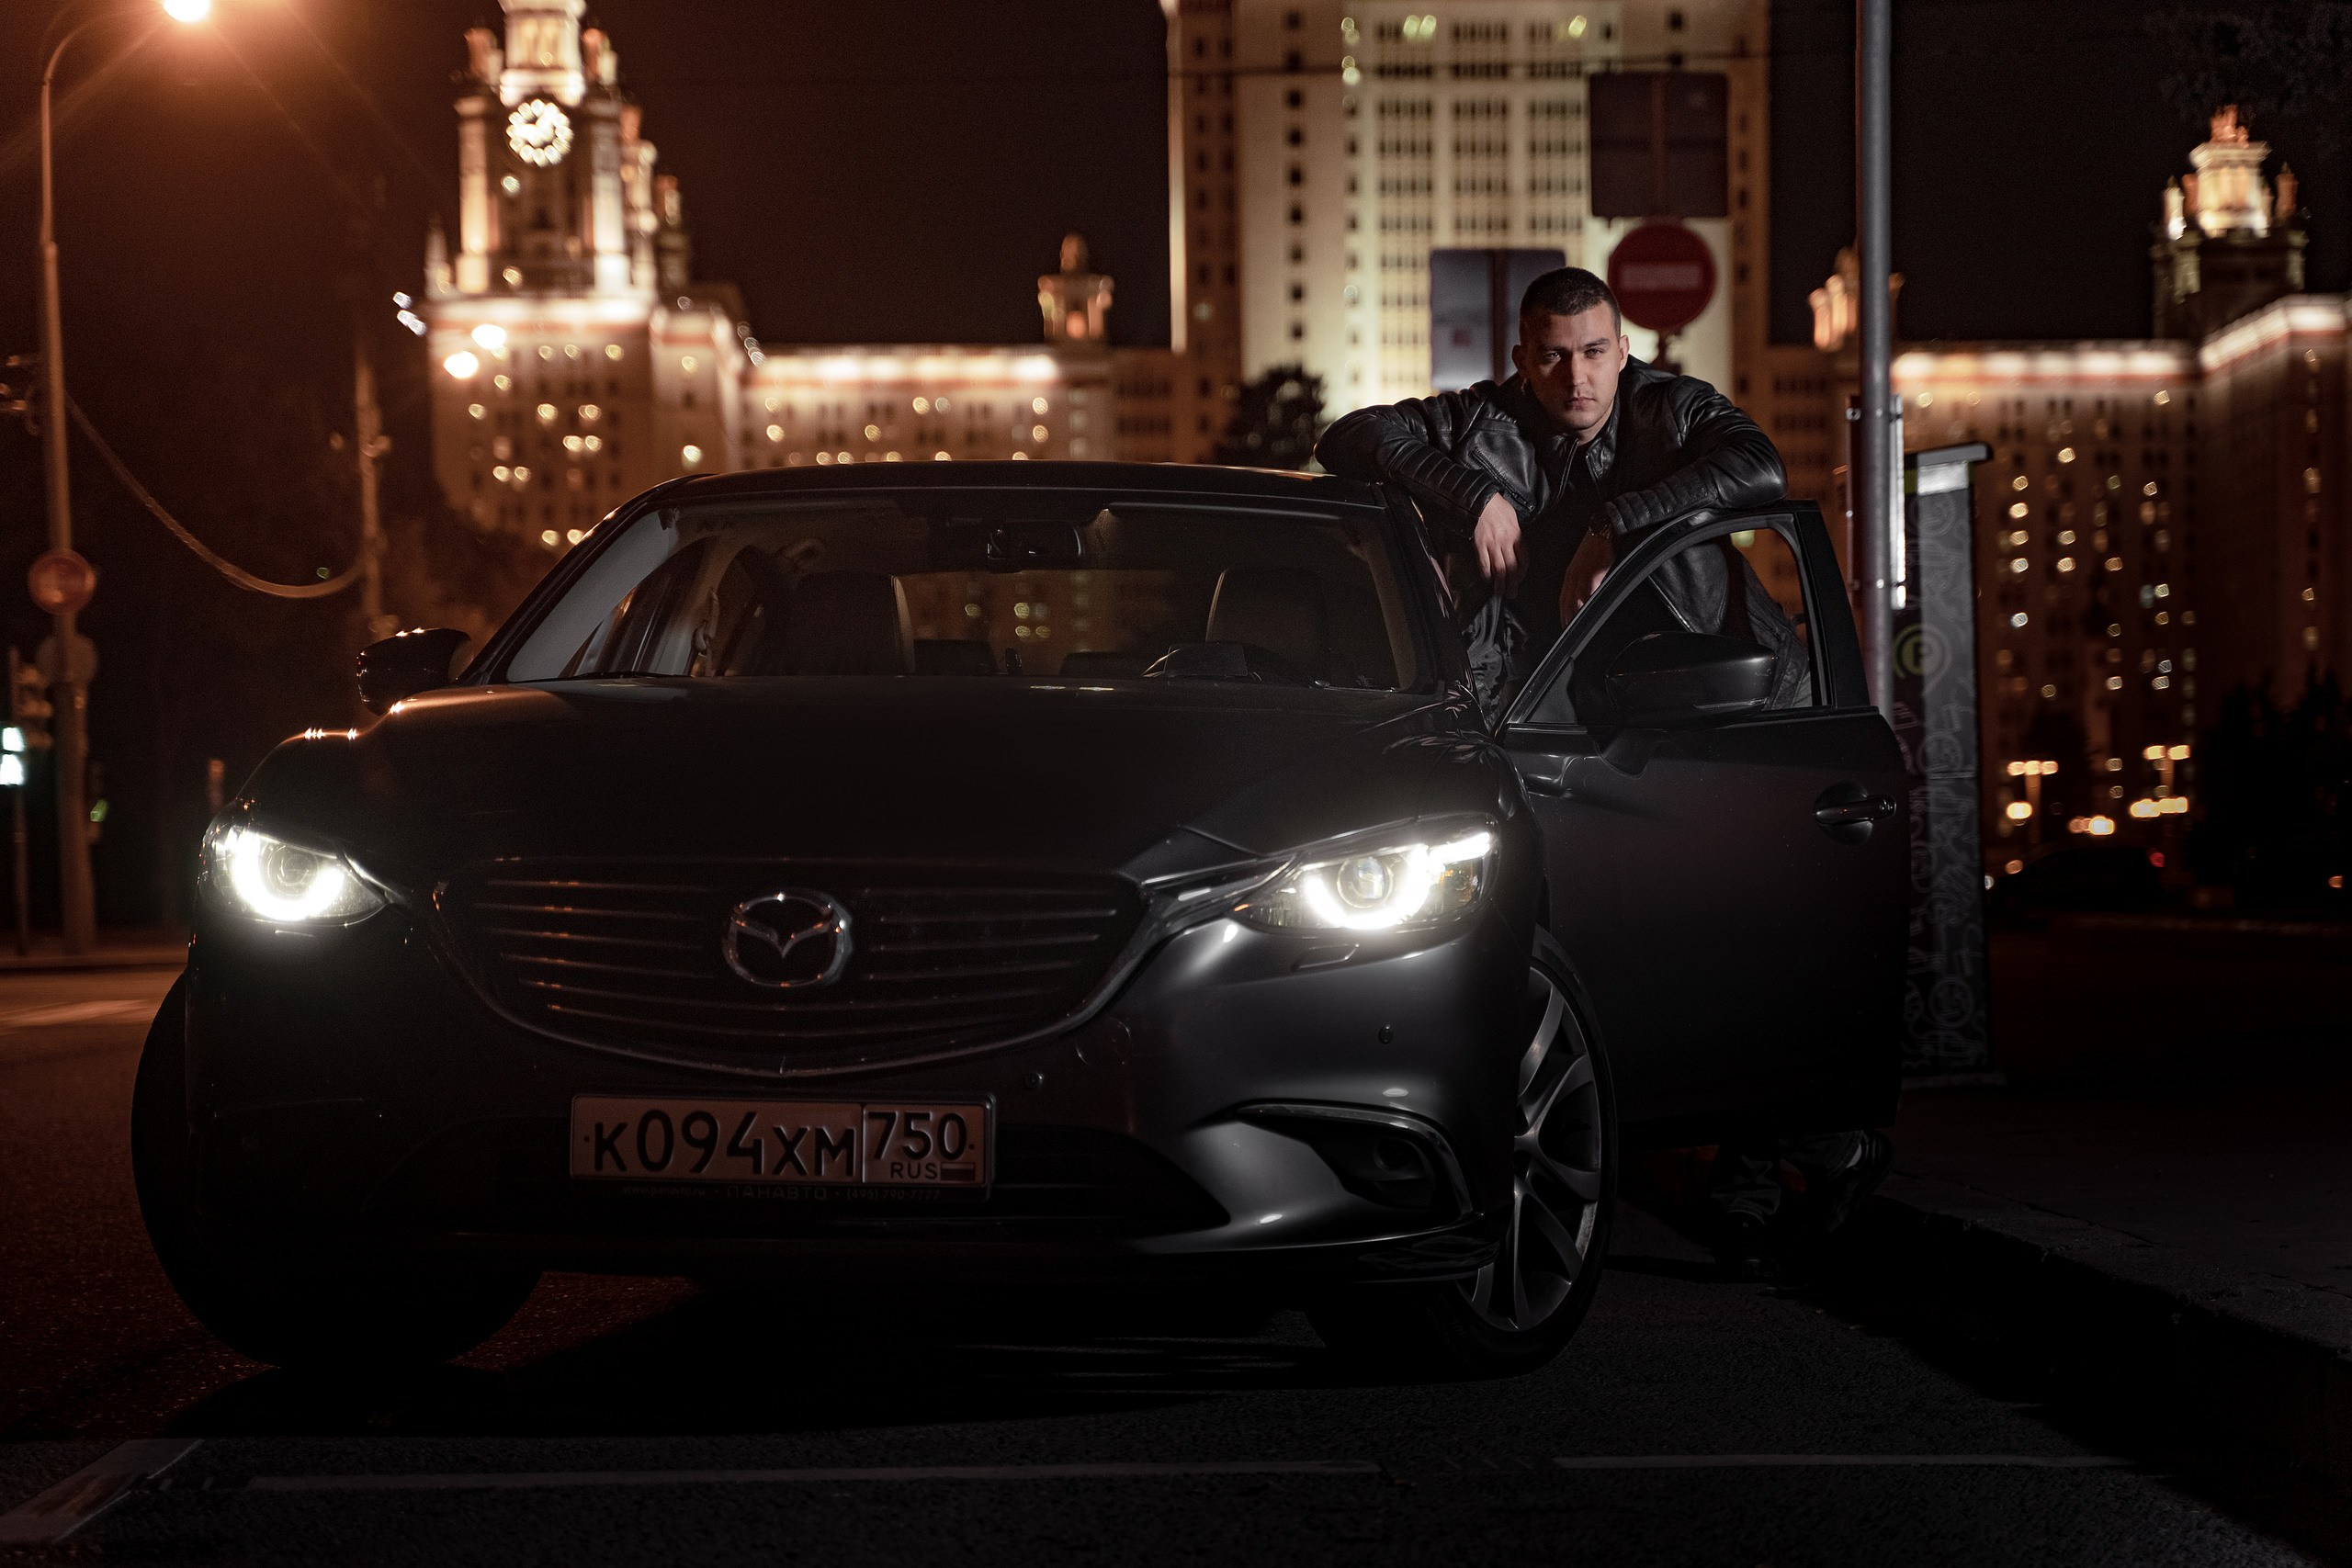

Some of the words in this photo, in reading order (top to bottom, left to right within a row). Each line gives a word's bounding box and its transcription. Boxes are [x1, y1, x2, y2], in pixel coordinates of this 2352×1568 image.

[867, 1111, 967, 1160] 750
[890, 1162, 937, 1179] RUS
[727, 1185, 827, 1200] ПАНАВТО
